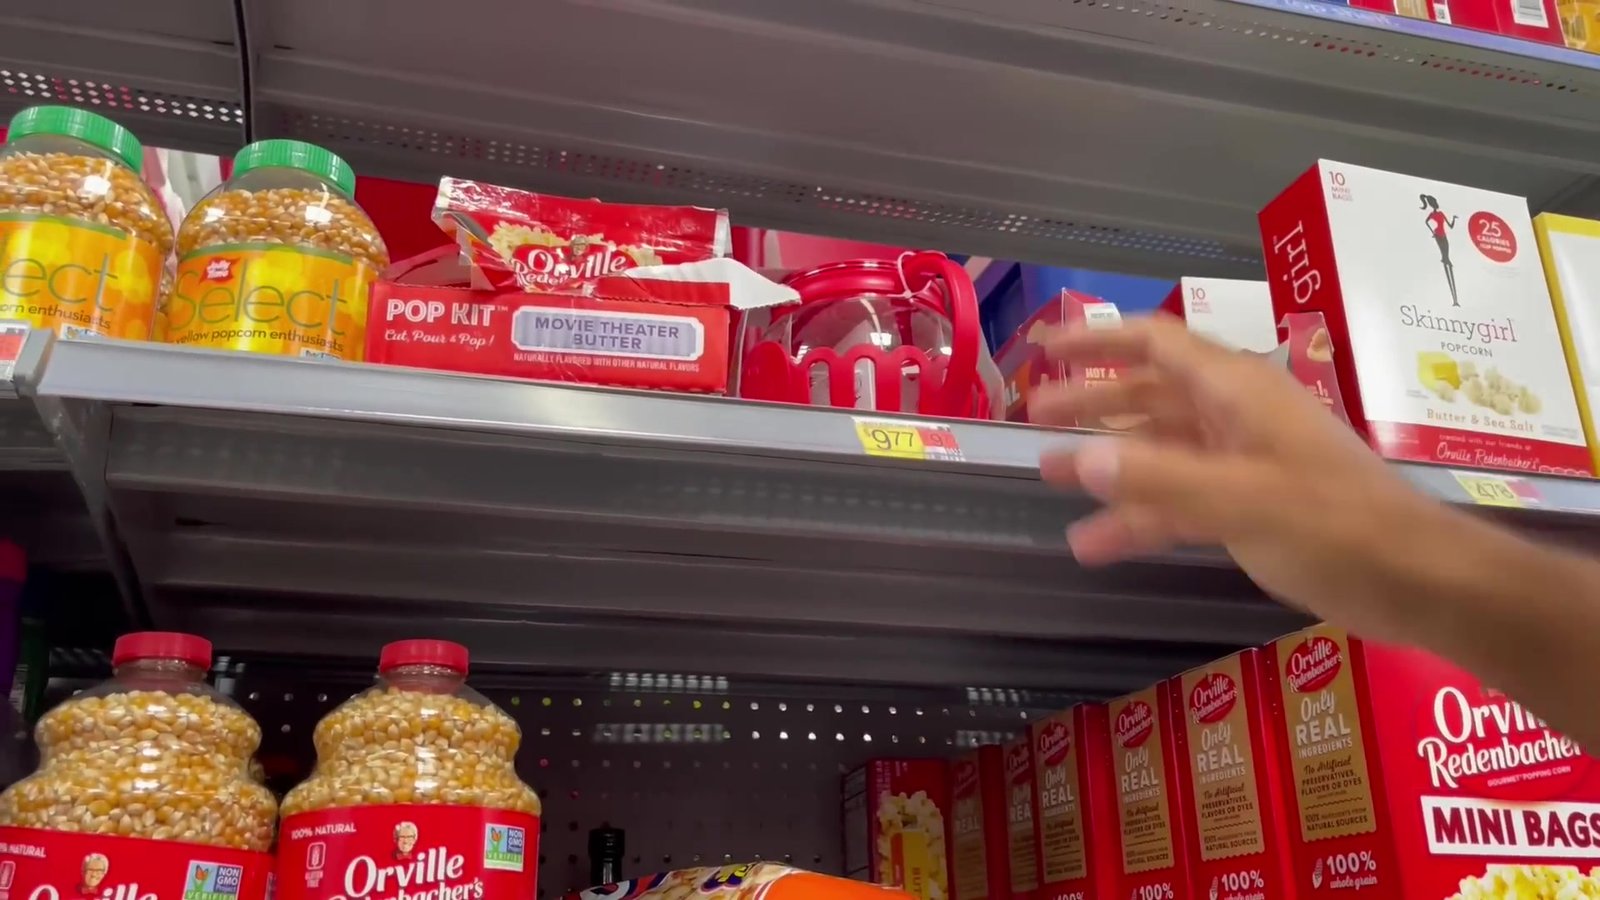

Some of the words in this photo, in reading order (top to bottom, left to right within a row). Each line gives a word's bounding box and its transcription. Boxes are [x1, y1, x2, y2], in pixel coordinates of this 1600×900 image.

[1328, 171, 1346, 186] 10
[1478, 219, 1502, 237] 25
[1273, 220, 1321, 304] girl
[172, 258, 347, 336] Select
[28, 305, 111, 330] enthusiasts
[386, 298, 446, 323] POP
[535, 317, 594, 332] MOVIE
[600, 321, 679, 339] THEATER
[1400, 305, 1517, 344] Skinnygirl
[211, 329, 266, 341] popcorn
[270, 331, 344, 352] enthusiasts
[412, 330, 447, 343] Pour
[574, 334, 641, 349] BUTTER
[1441, 341, 1493, 358] POPCORN
[513, 352, 553, 363] NATURALLY
[555, 354, 591, 365] FLAVORED
[593, 357, 611, 367] WITH
[612, 358, 635, 368] OTHER
[636, 360, 667, 371] NATURAL
[1085, 367, 1106, 378] HOT
[1427, 408, 1466, 424] Butter
[1471, 415, 1479, 425] &
[1484, 416, 1506, 428] Sea
[1510, 419, 1535, 432] Salt
[1436, 442, 1472, 462] Orville
[1292, 640, 1332, 675] Orville
[1194, 676, 1229, 708] Orville
[1301, 690, 1334, 722] Only
[1119, 703, 1148, 732] Orville
[1202, 722, 1231, 751] Only
[1296, 713, 1350, 746] REAL
[1197, 744, 1244, 773] REAL
[1298, 737, 1353, 759] INGREDIENTS
[1125, 747, 1148, 772] Only
[1304, 764, 1315, 775] No
[1317, 754, 1351, 772] Artificial
[1121, 767, 1159, 793] REAL
[1199, 766, 1246, 784] INGREDIENTS
[1522, 769, 1552, 782] POPPING
[1552, 765, 1571, 776] CORN
[1042, 784, 1074, 808] REAL
[1301, 784, 1330, 796] FLAVORS
[1344, 777, 1362, 788] DYES
[314, 822, 357, 836] NATURAL
[1307, 820, 1335, 831] NATURAL
[1336, 815, 1368, 827] SOURCES
[1432, 807, 1517, 846] MINI
[218, 867, 239, 877] NON
[344, 846, 465, 899] Orville
[1327, 850, 1377, 875] 100%
[217, 876, 238, 886] GMO
[1140, 882, 1174, 900] 100%
[1221, 869, 1264, 891] 100%
[1330, 876, 1354, 889] whole
[1355, 874, 1378, 890] grain
